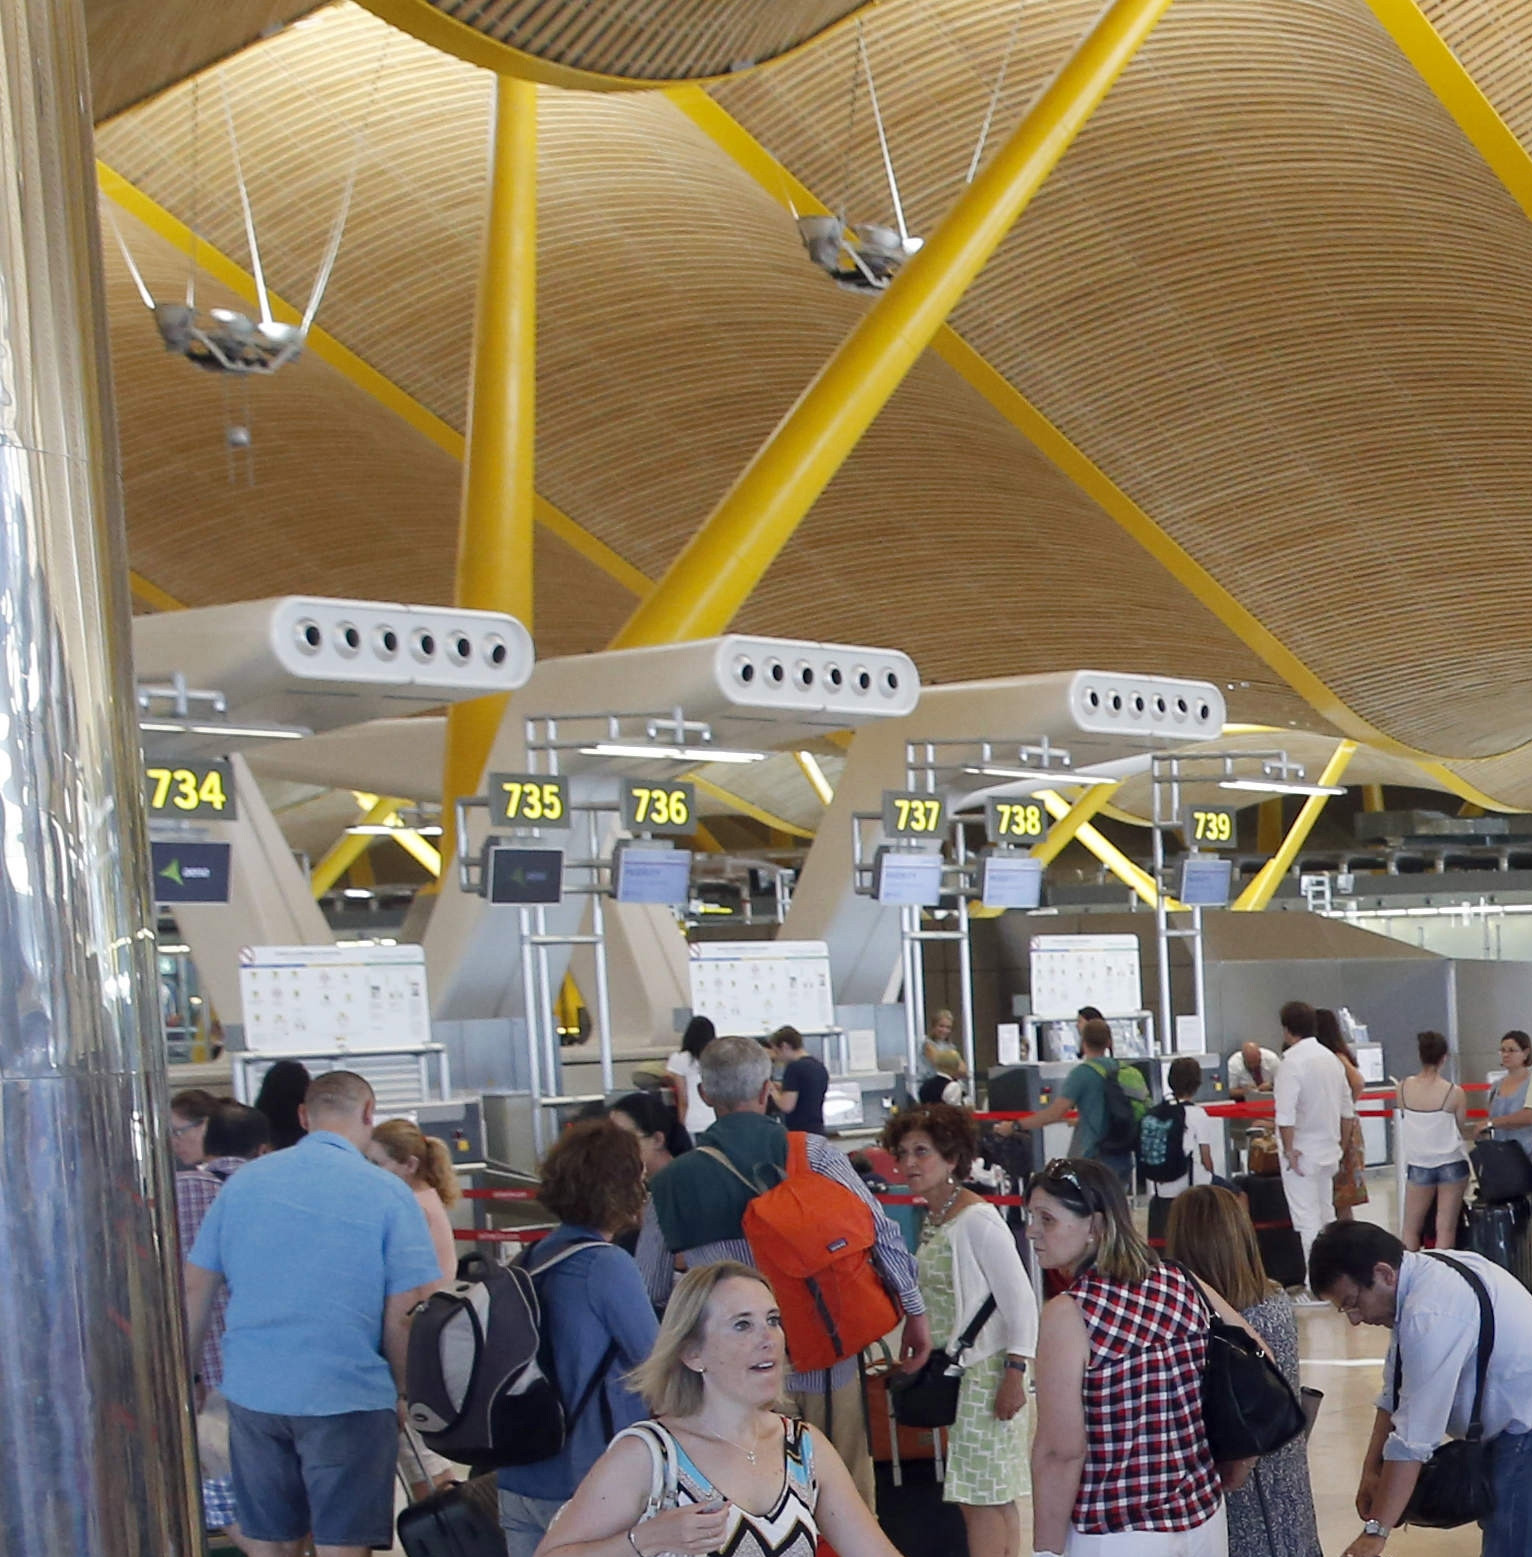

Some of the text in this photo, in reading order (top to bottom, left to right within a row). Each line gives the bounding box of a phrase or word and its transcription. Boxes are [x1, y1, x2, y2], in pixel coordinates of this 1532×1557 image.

[147, 768, 226, 811] 734
[502, 782, 562, 820] 735
[632, 787, 688, 825] 736
[895, 799, 941, 832] 737
[997, 803, 1042, 836] 738
[1194, 810, 1231, 841] 739
